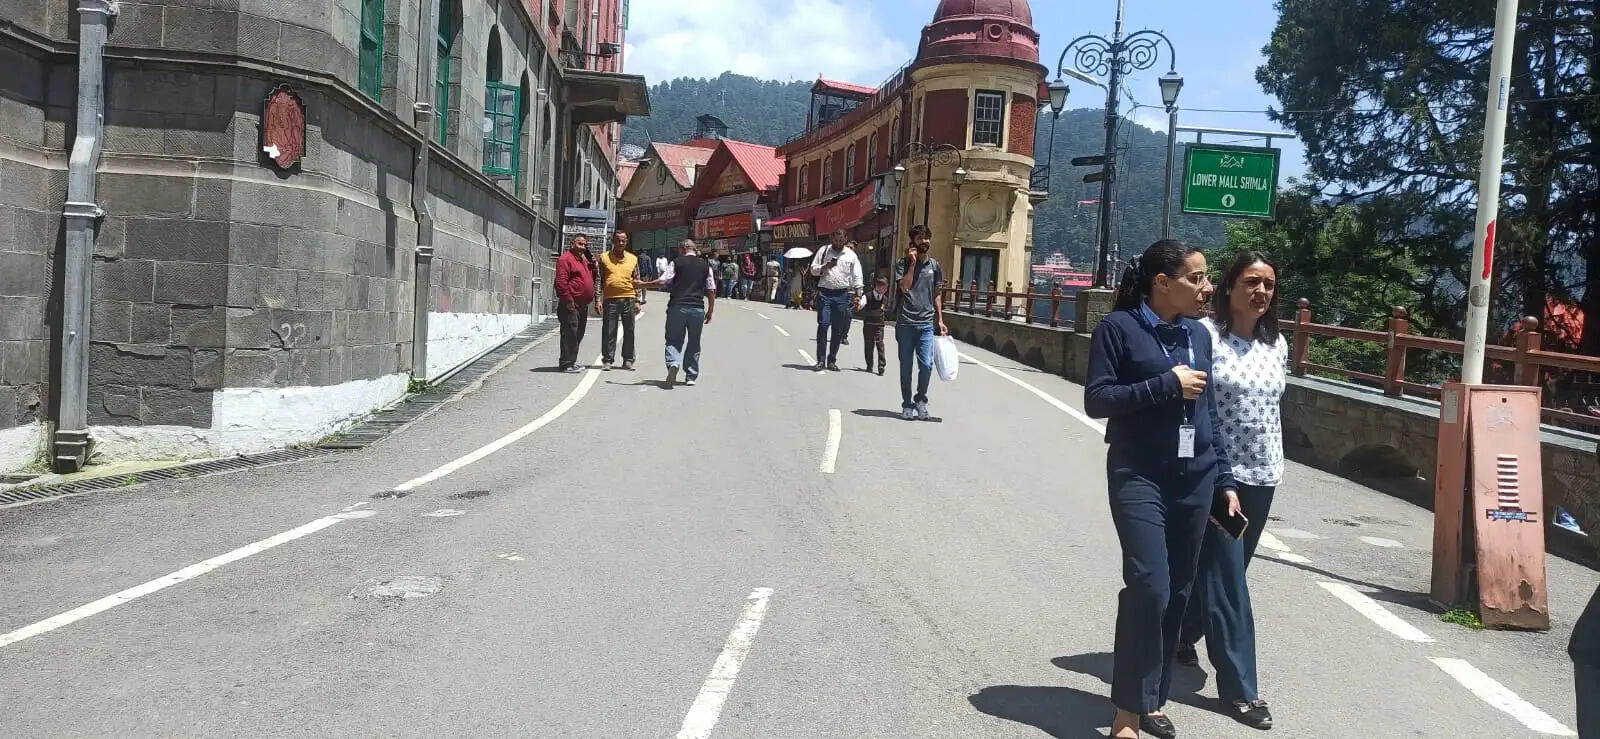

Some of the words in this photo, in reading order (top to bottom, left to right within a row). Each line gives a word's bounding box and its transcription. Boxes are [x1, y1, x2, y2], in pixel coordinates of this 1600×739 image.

[1192, 173, 1217, 187] LOWER
[1218, 175, 1238, 189] MALL
[1240, 177, 1267, 191] SHIMLA
[773, 225, 787, 239] CITY
[788, 223, 809, 238] POINT
